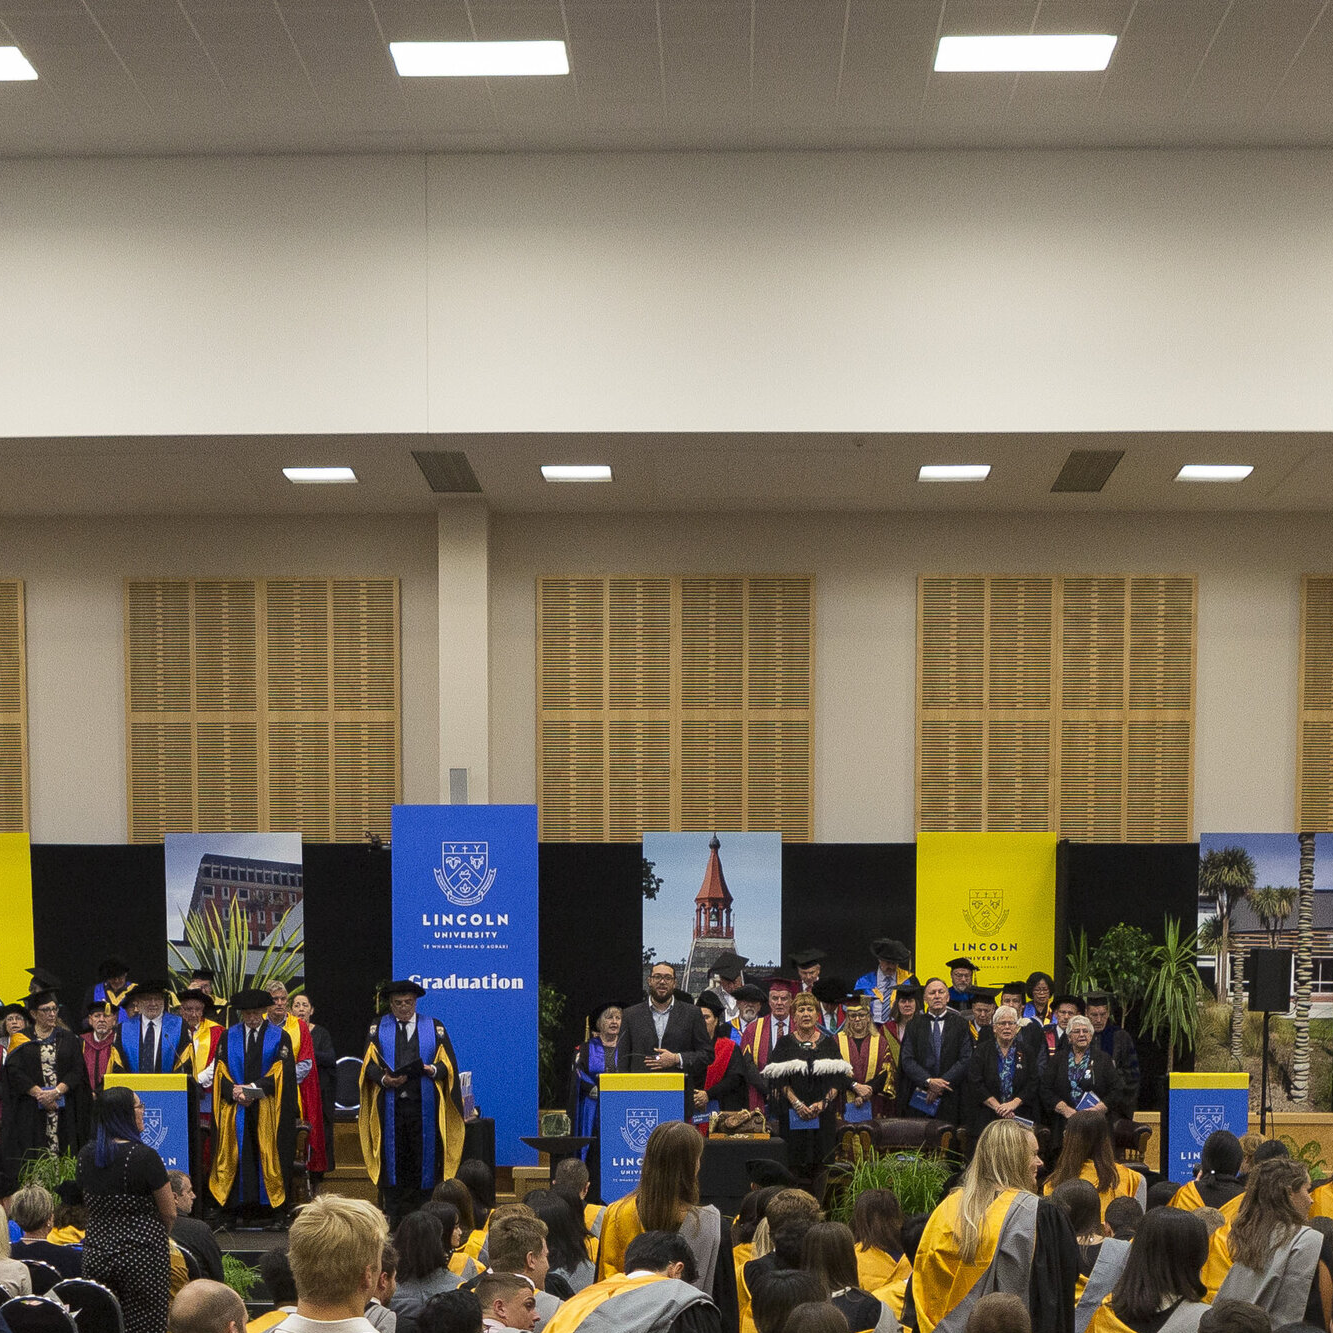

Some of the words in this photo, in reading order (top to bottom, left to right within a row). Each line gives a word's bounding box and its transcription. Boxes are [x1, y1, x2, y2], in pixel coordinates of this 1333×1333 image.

[422, 914, 509, 926] LINCOLN
[434, 931, 498, 939] UNIVERSITY
[953, 943, 1018, 952] LINCOLN
